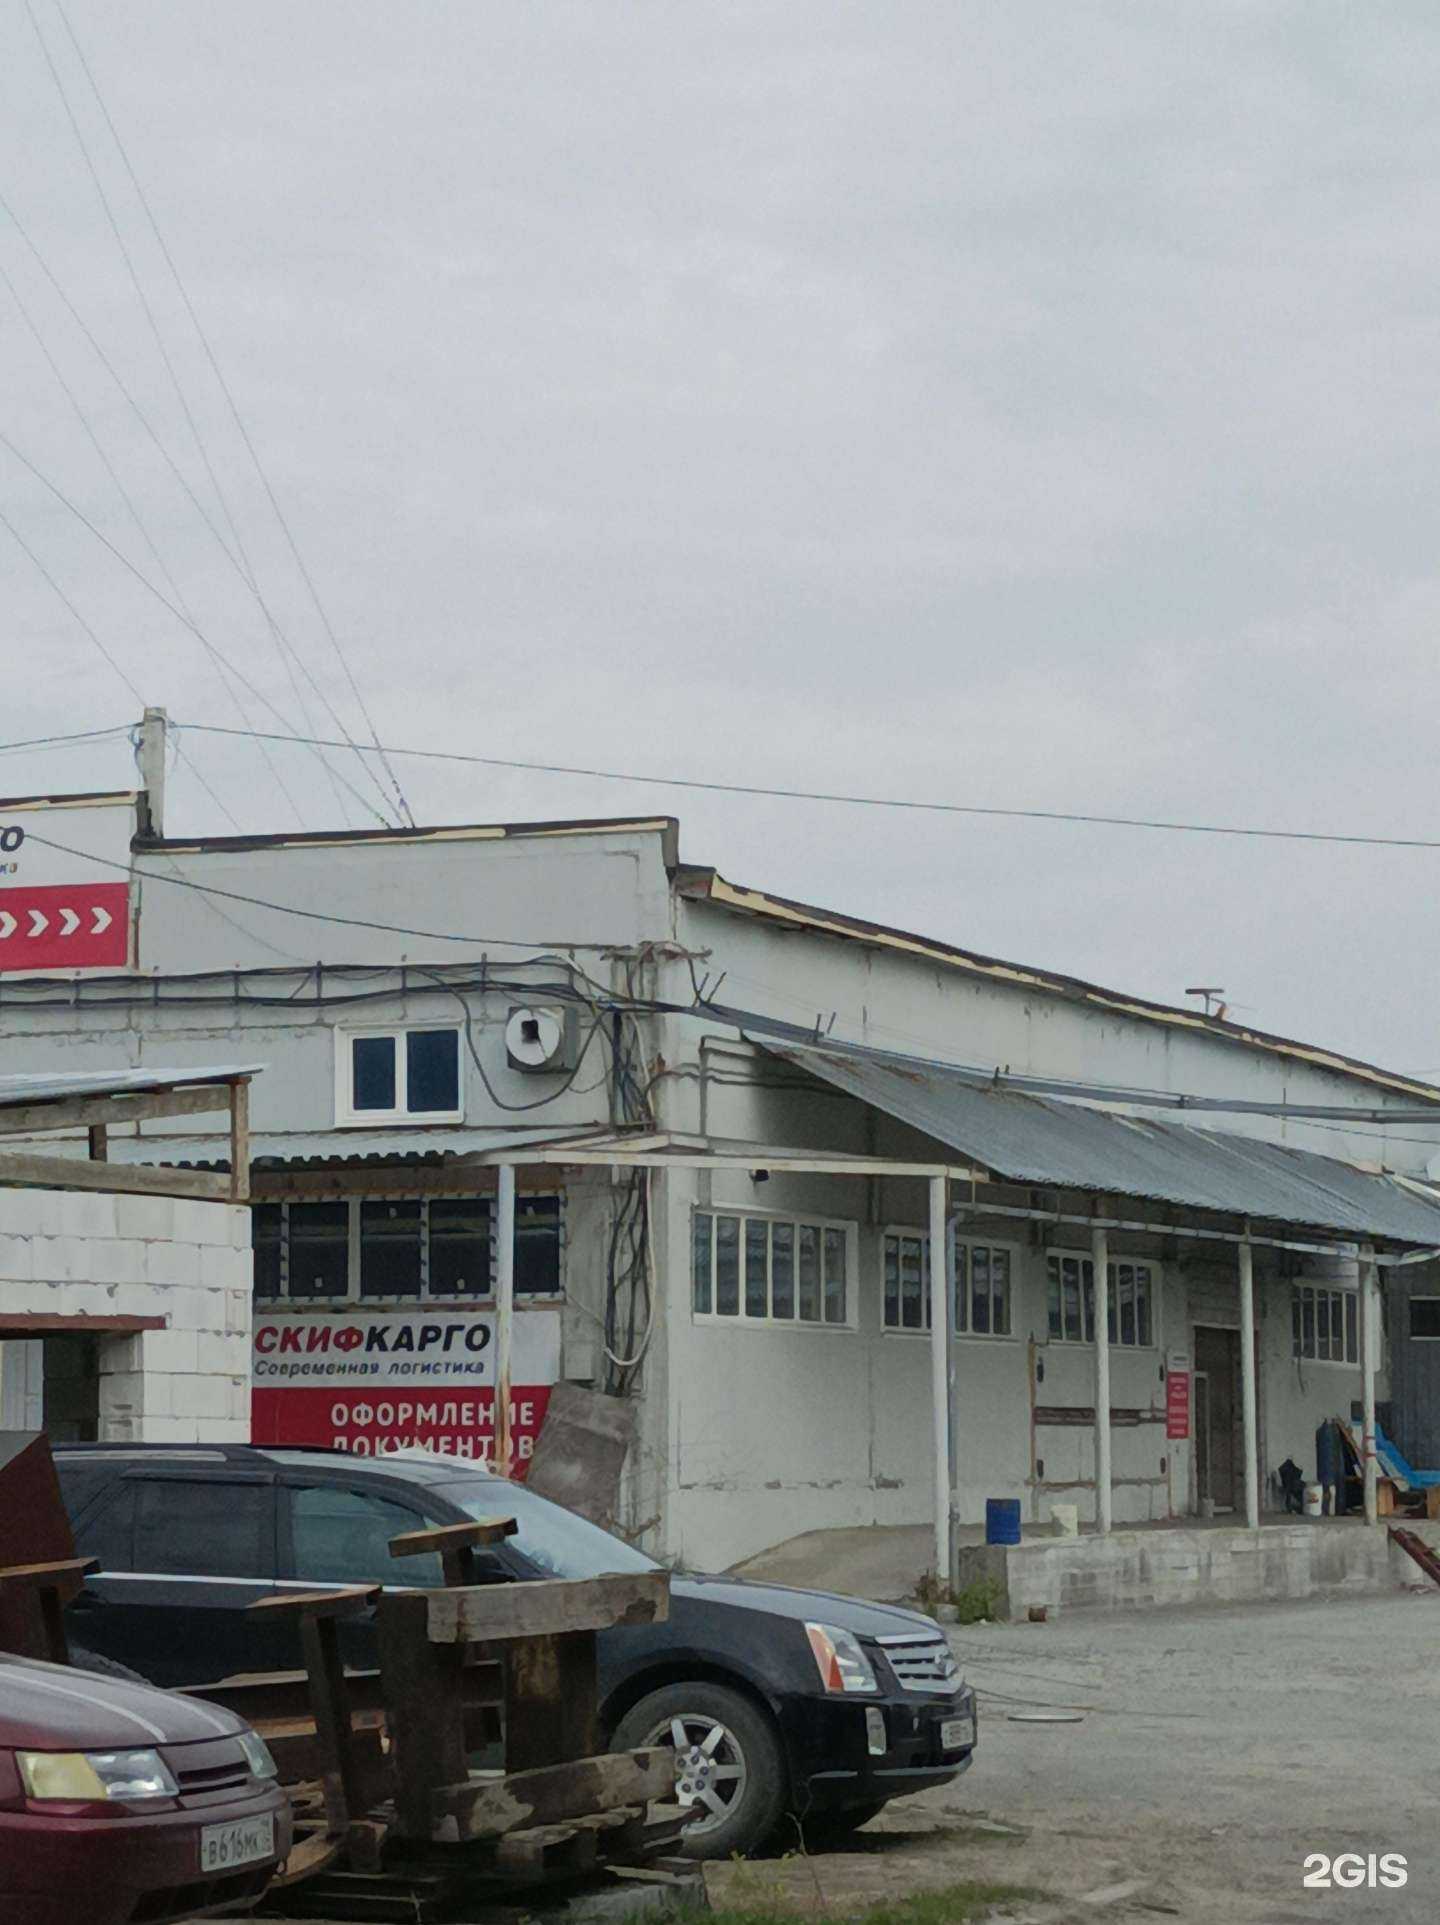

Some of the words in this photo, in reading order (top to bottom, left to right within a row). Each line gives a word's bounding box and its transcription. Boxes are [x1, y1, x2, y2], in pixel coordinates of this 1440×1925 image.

[255, 1324, 491, 1353] СКИФКАРГО
[254, 1360, 380, 1378] Современная
[388, 1360, 485, 1376] логистика
